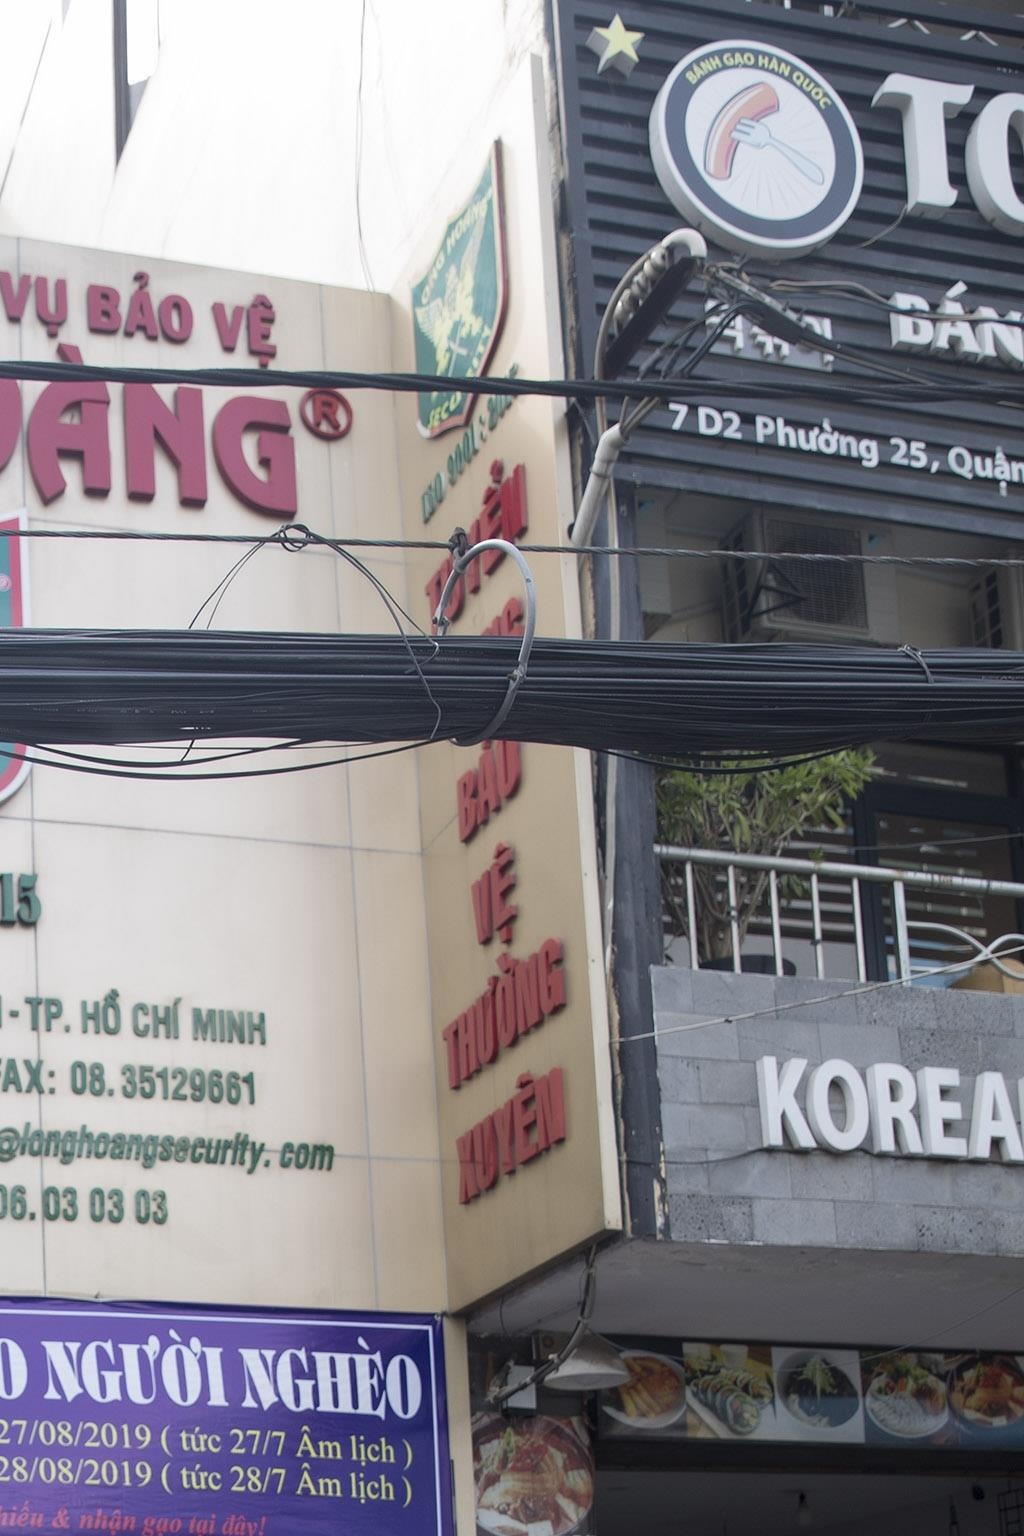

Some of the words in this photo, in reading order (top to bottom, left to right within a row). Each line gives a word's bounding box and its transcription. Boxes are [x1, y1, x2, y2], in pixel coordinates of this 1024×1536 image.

[86, 271, 193, 345] BẢO
[211, 293, 277, 368] VỆ
[697, 407, 742, 441] D2
[889, 437, 940, 475] 25,
[471, 842, 518, 945] VỆ
[81, 988, 121, 1037] HỒ
[133, 997, 182, 1041] CHÍ
[192, 1008, 267, 1046] MINH
[442, 937, 568, 1090] THƯỜNG
[455, 1066, 566, 1205] XUYÊN
[755, 1055, 1024, 1164] KOREA
[90, 1187, 125, 1224] 03
[135, 1189, 169, 1225] 03
[40, 1328, 230, 1408] NGƯỜI
[238, 1335, 423, 1420] NGHÈO
[180, 1426, 222, 1455] tức
[229, 1428, 285, 1458] 27/7
[295, 1426, 343, 1461] Âm
[350, 1436, 395, 1471] lịch
[180, 1463, 222, 1493] tức
[229, 1466, 286, 1495] 28/7
[295, 1463, 343, 1498] Âm
[350, 1473, 395, 1507] lịch
[52, 1508, 70, 1529] &
[79, 1508, 137, 1535] nhận
